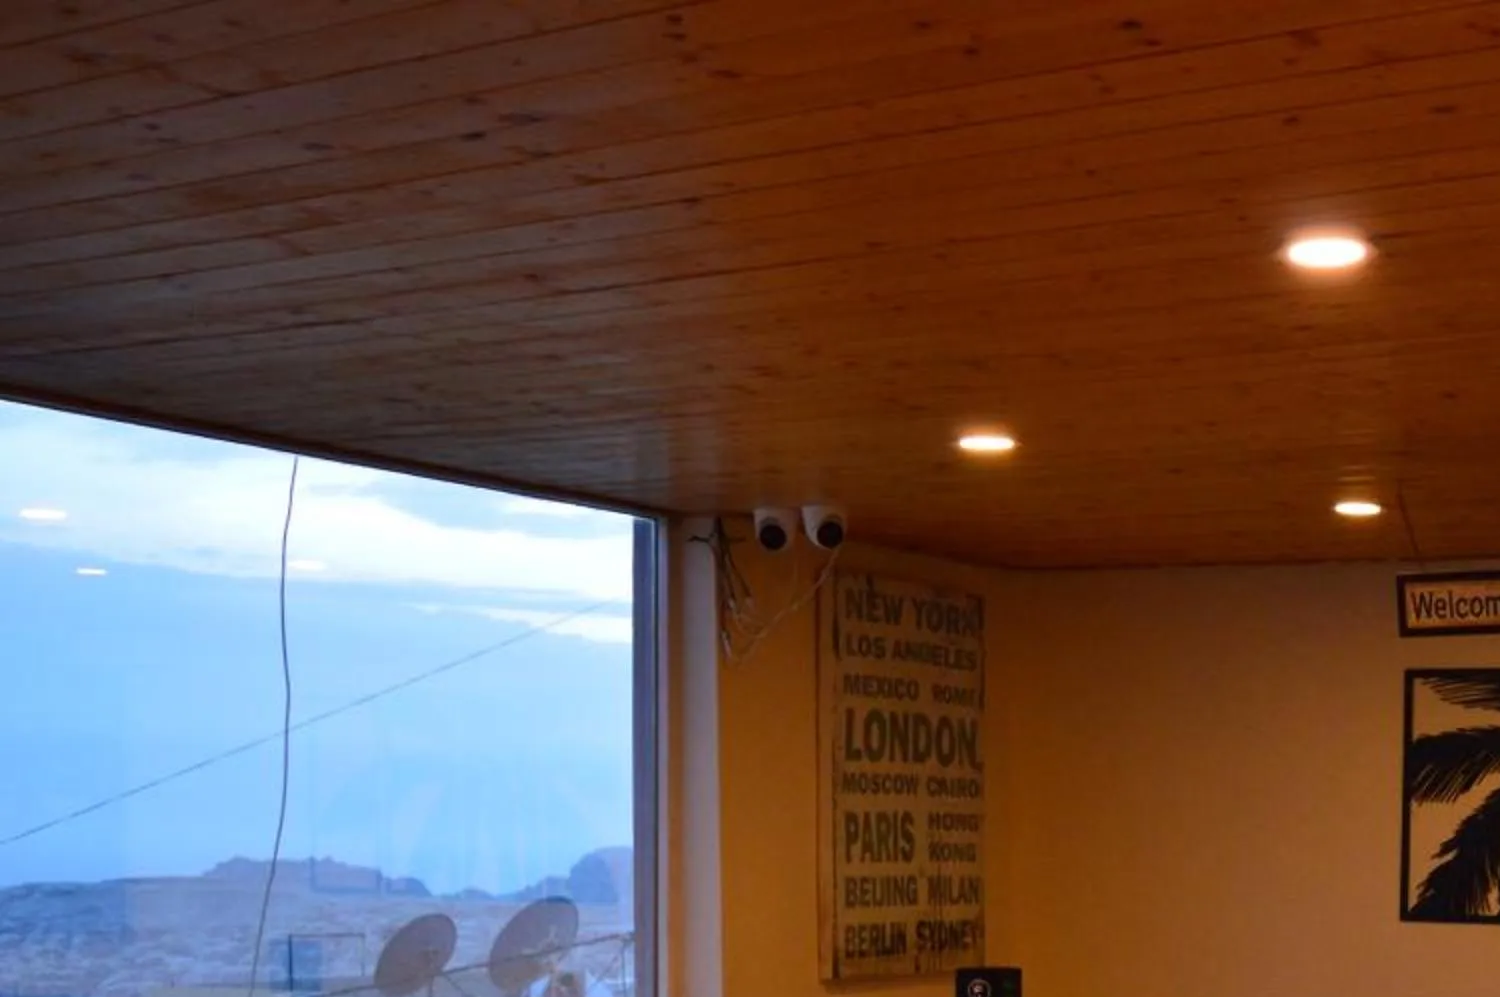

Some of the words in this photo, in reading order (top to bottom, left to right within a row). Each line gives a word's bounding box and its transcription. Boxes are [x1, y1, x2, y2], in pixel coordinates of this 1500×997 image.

[845, 587, 904, 626] NEW
[911, 597, 981, 638] YORK
[845, 633, 886, 660] LOS
[892, 638, 977, 672] ANGELES
[843, 673, 920, 701] MEXICO
[931, 682, 978, 706] ROME
[845, 708, 981, 767] LONDON
[842, 772, 918, 797] MOSCOW
[926, 774, 980, 799] CAIRO
[845, 810, 915, 864] PARIS
[928, 812, 979, 833] HONG
[928, 841, 977, 863] KONG
[845, 876, 918, 907] BEIJING
[928, 874, 979, 906] MILAN
[845, 923, 907, 960] BERLIN
[915, 919, 981, 954] SYDNEY
